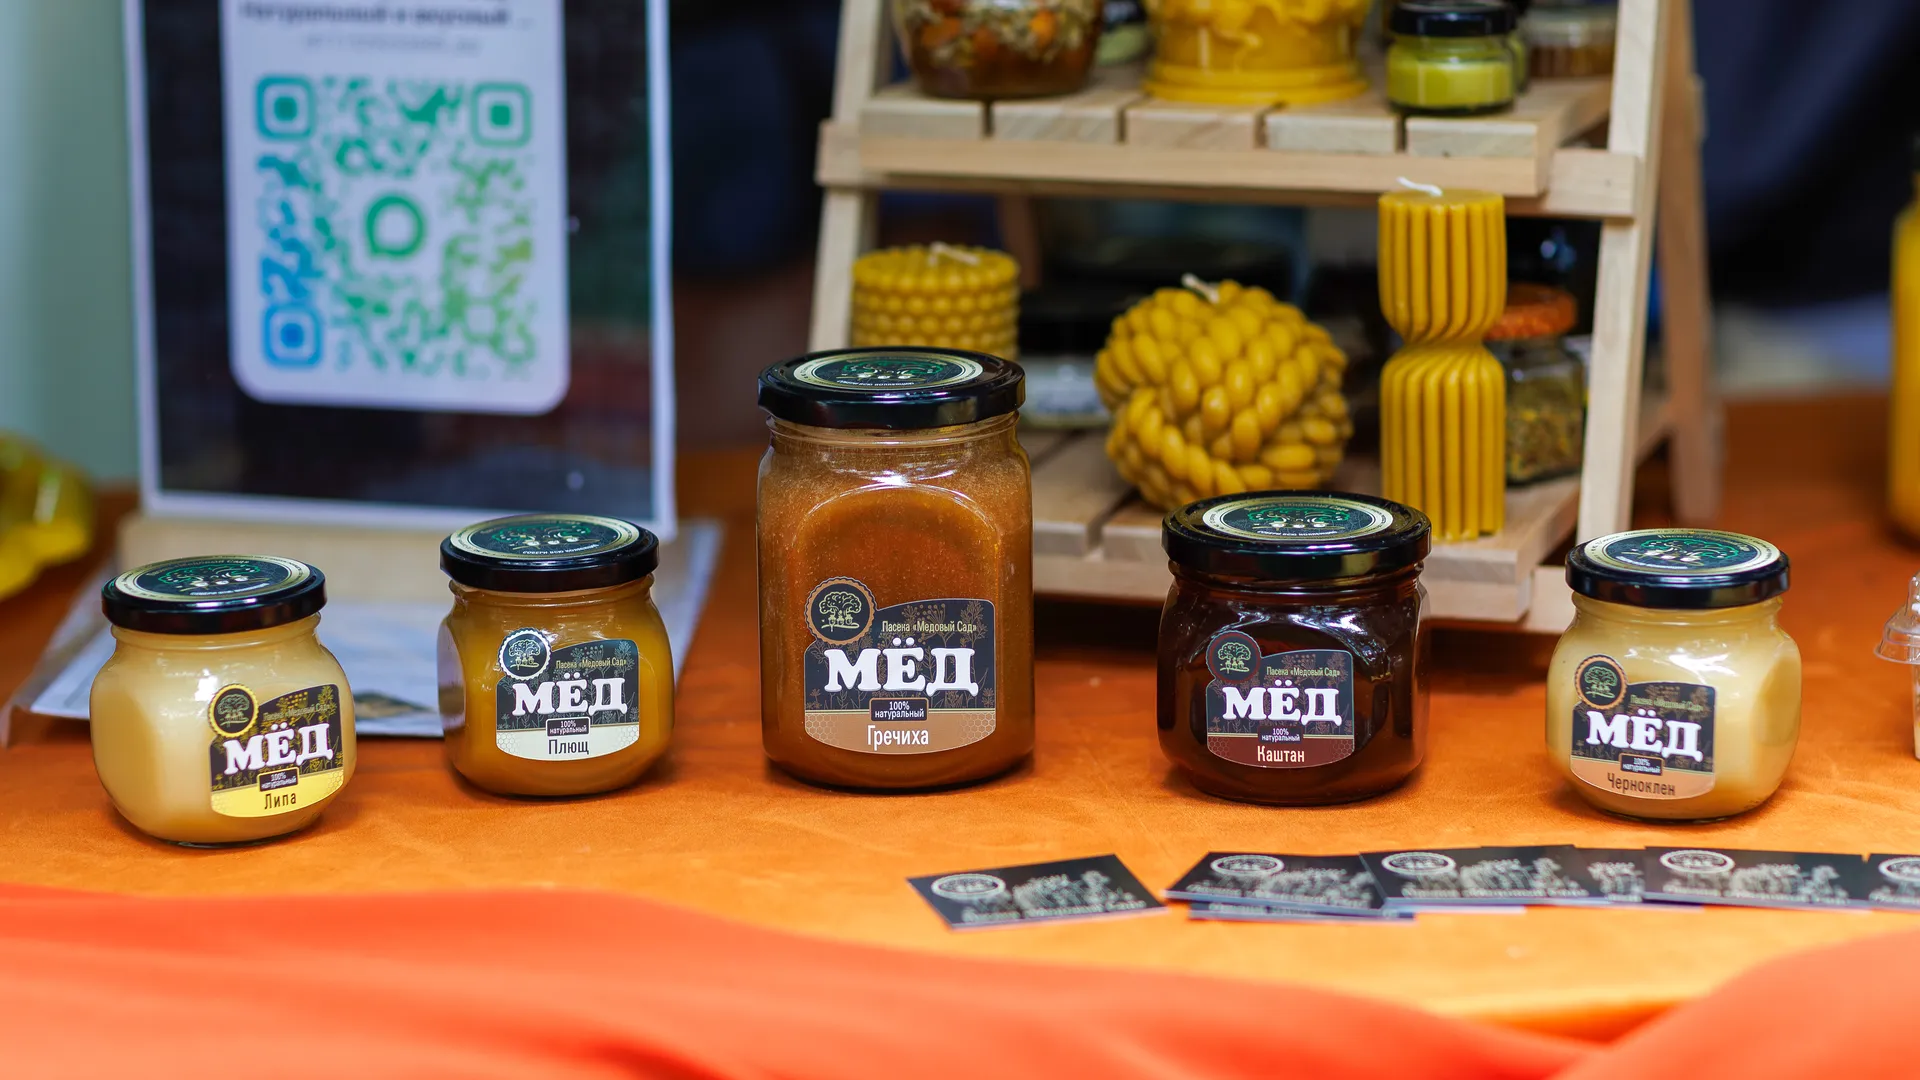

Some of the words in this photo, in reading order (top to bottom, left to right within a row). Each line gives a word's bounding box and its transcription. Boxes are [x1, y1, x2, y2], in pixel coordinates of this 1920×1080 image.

[882, 620, 910, 632] Пасека
[912, 619, 955, 633] «Медовый
[956, 620, 977, 633] Сад»
[824, 637, 979, 697] МЁД
[512, 672, 628, 716] МЁД
[889, 701, 910, 711] 100%
[1222, 679, 1342, 727] МЁД
[874, 708, 925, 720] натуральный
[549, 725, 588, 736] натуральный
[560, 720, 577, 728] 100%
[867, 725, 929, 751] Гречиха
[1261, 734, 1301, 743] натуральный
[1586, 708, 1704, 763] МЁД
[223, 722, 334, 775] МЁД
[548, 739, 590, 755] Плющ
[1257, 745, 1305, 762] Каштан
[1607, 772, 1676, 796] Черноклен
[264, 792, 297, 810] Липа
